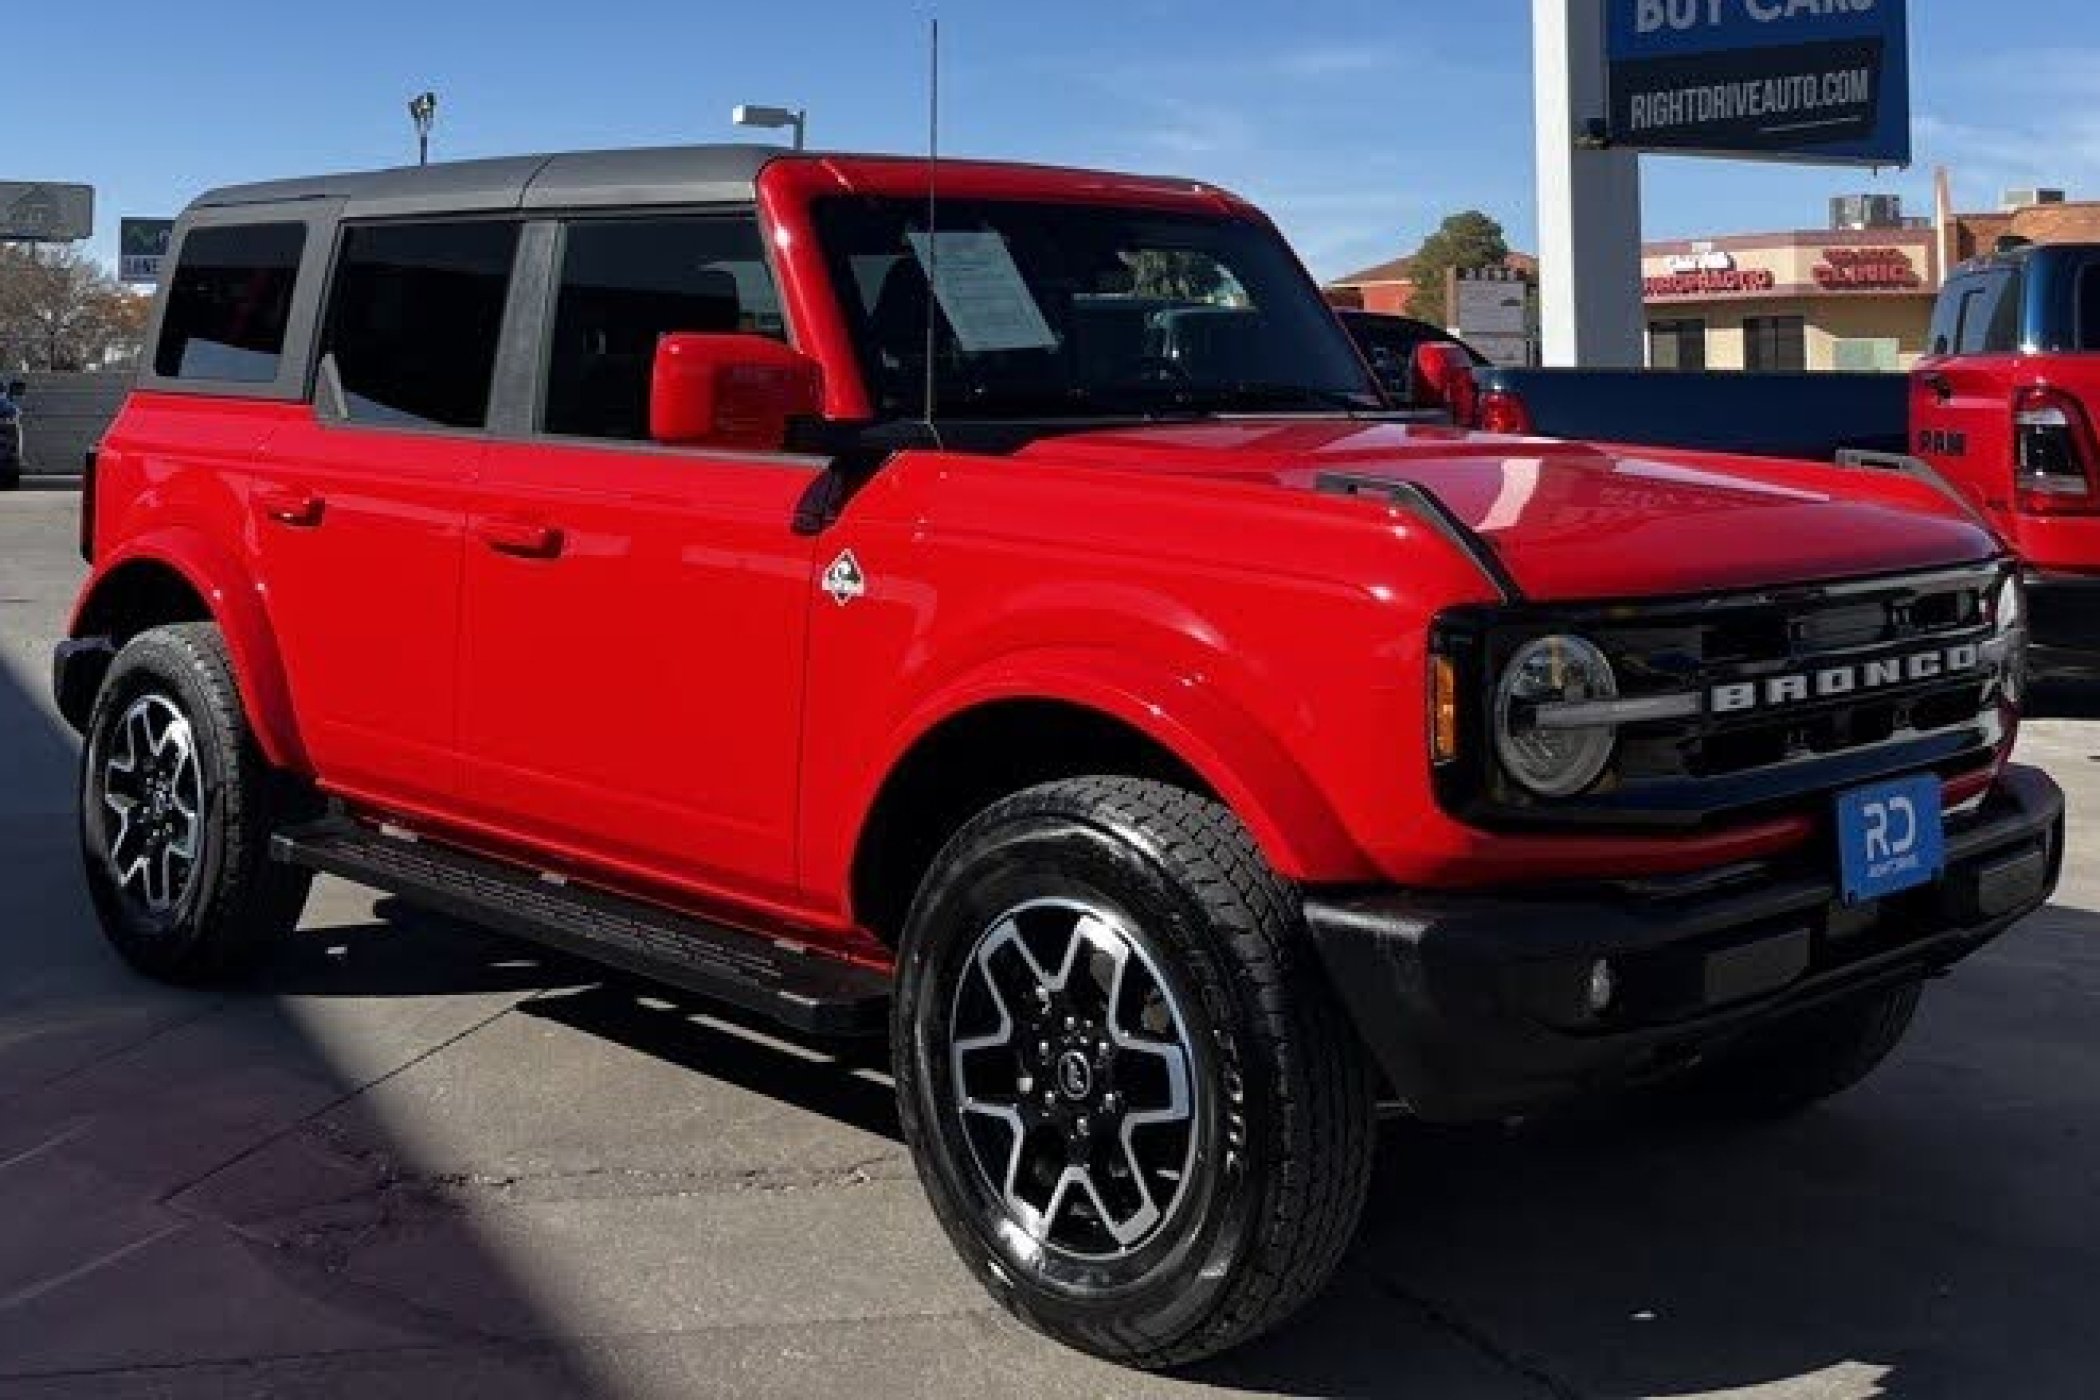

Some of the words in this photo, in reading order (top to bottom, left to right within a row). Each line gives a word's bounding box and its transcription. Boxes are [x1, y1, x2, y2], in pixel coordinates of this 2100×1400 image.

[1631, 69, 1868, 129] RIGHTDRIVEAUTO.COM
[1711, 645, 1976, 711] BRONCO
[1864, 797, 1915, 861] RD
